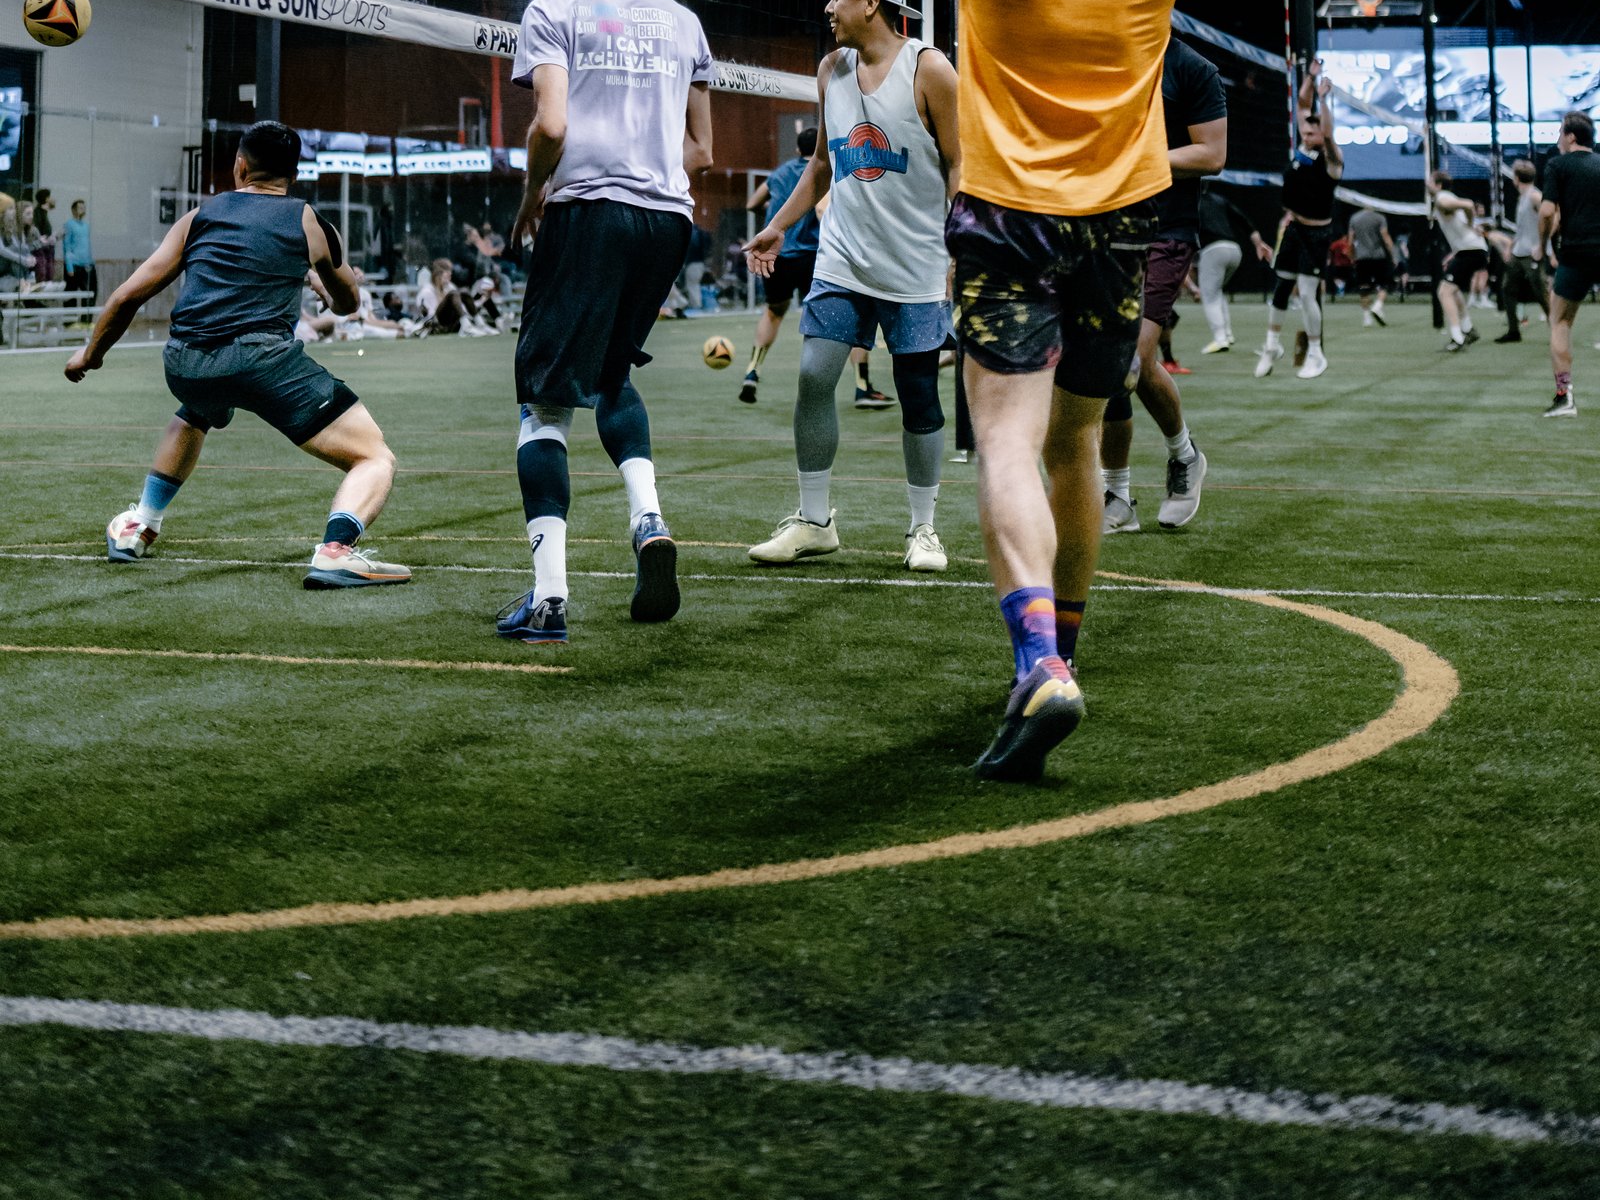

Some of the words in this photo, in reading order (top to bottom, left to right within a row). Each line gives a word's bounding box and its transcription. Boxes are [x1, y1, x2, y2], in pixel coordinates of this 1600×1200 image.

[489, 24, 519, 55] PAR
[606, 34, 612, 50] I
[616, 36, 653, 54] CAN
[579, 52, 654, 70] ACHIEVE
[641, 77, 652, 88] ALI
